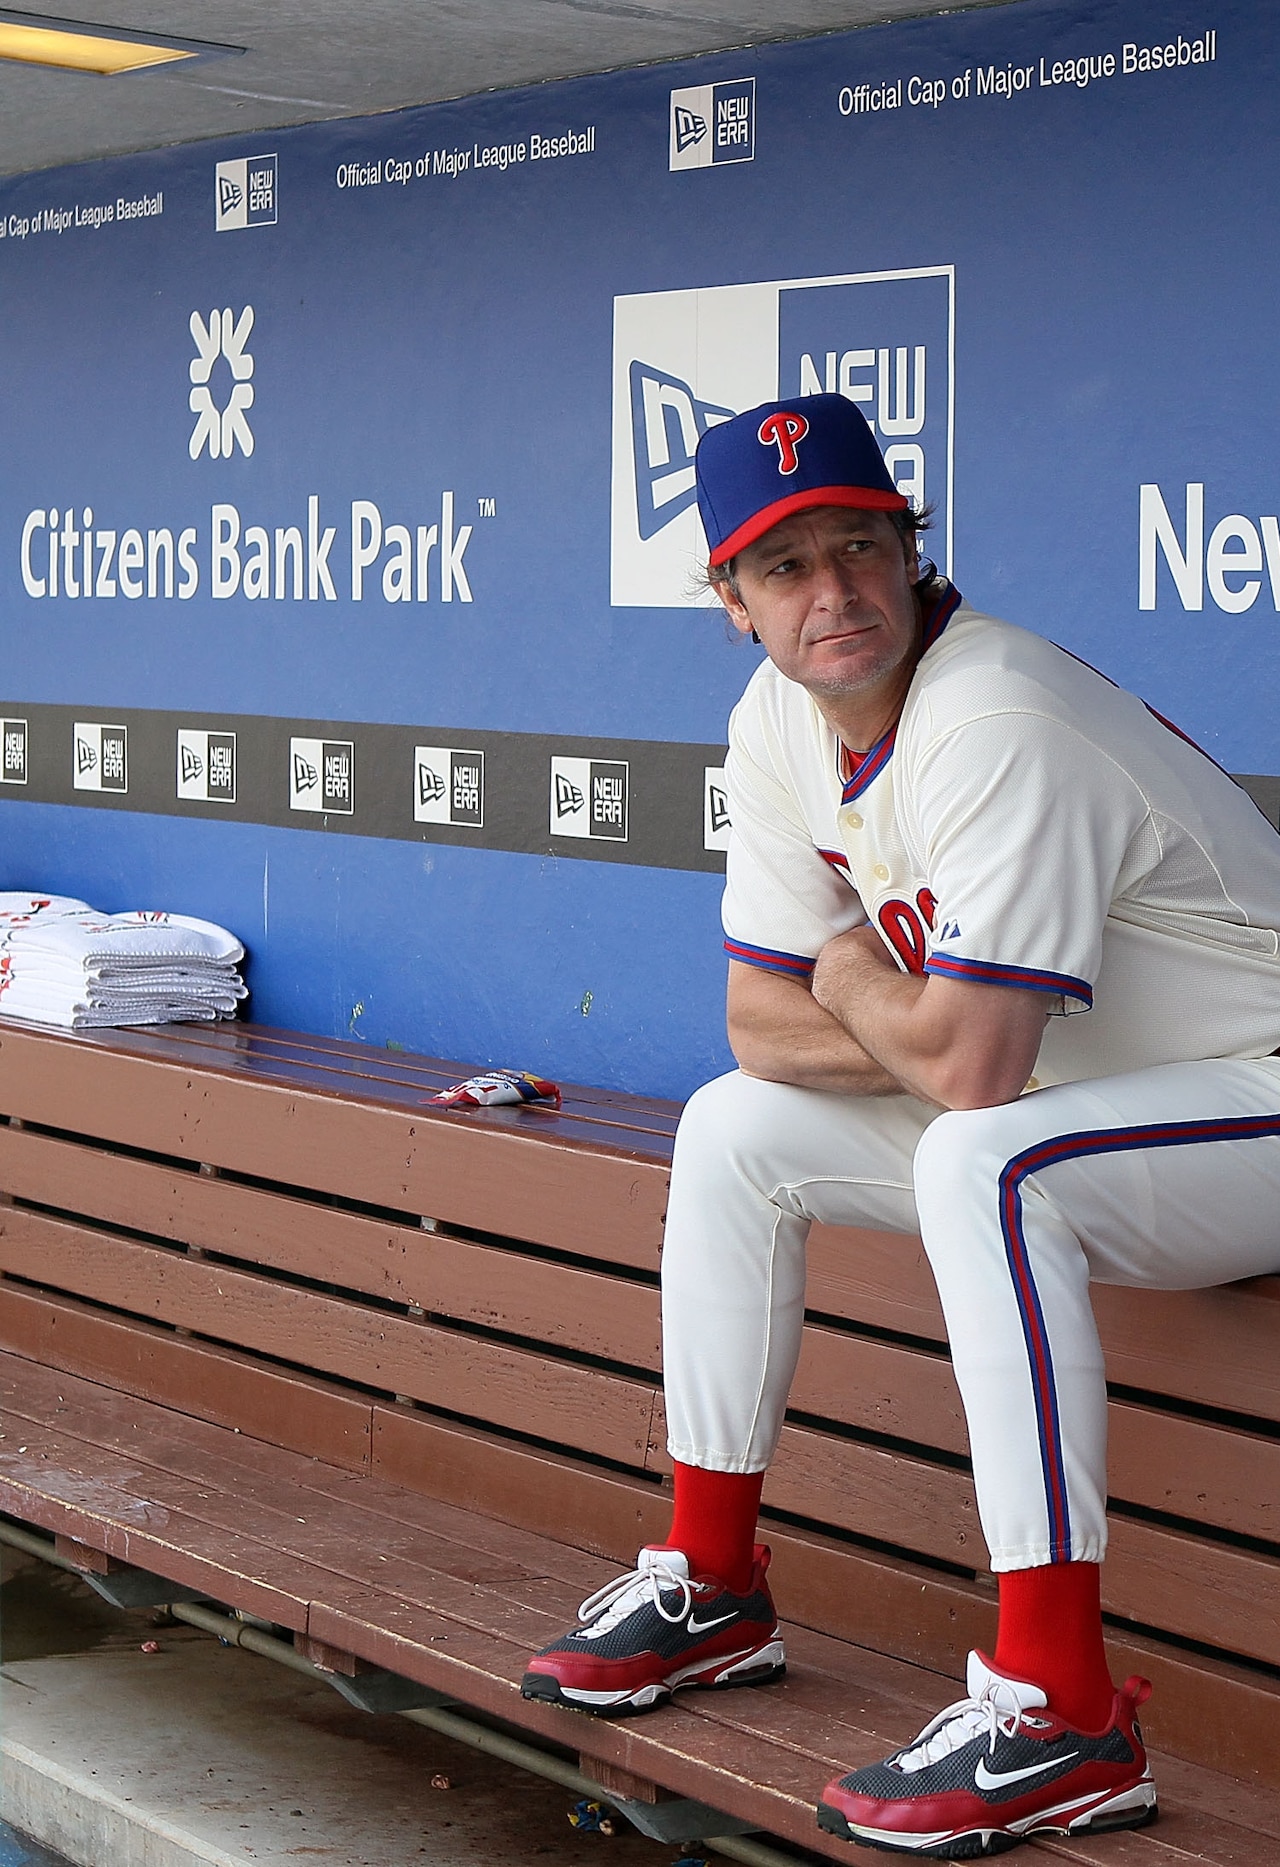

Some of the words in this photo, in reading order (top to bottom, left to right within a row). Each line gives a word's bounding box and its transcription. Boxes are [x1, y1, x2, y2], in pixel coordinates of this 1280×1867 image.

[838, 79, 902, 116] Official
[907, 75, 946, 109] Cap
[951, 68, 972, 99] of
[977, 62, 1035, 99] Major
[1039, 51, 1116, 88] League
[1122, 29, 1217, 74] Baseball
[718, 97, 749, 123] NEW
[718, 120, 748, 146] ERA
[336, 160, 382, 189] Official
[384, 157, 412, 186] Cap
[416, 153, 431, 177] of
[433, 149, 471, 178] Major
[473, 142, 526, 170] League
[529, 126, 596, 161] Baseball
[250, 170, 273, 191] NEW
[250, 190, 273, 211] ERA
[9, 214, 29, 239] Cap
[31, 209, 43, 233] of
[44, 207, 74, 234] Major
[75, 204, 114, 229] League
[116, 192, 163, 220] Baseball
[757, 411, 809, 476] P
[20, 506, 198, 600] Citizens
[211, 495, 337, 601] Bank
[351, 491, 473, 603] Park
[5, 733, 24, 752] NEW
[103, 739, 123, 759] NEW
[5, 751, 24, 770] ERA
[210, 746, 232, 767] NEW
[325, 756, 349, 777] NEW
[103, 759, 123, 778] ERA
[210, 767, 232, 787] ERA
[454, 766, 479, 789] NEW
[325, 777, 348, 798] ERA
[453, 787, 479, 811] ERA
[594, 776, 623, 801] NEW
[593, 800, 622, 824] ERA
